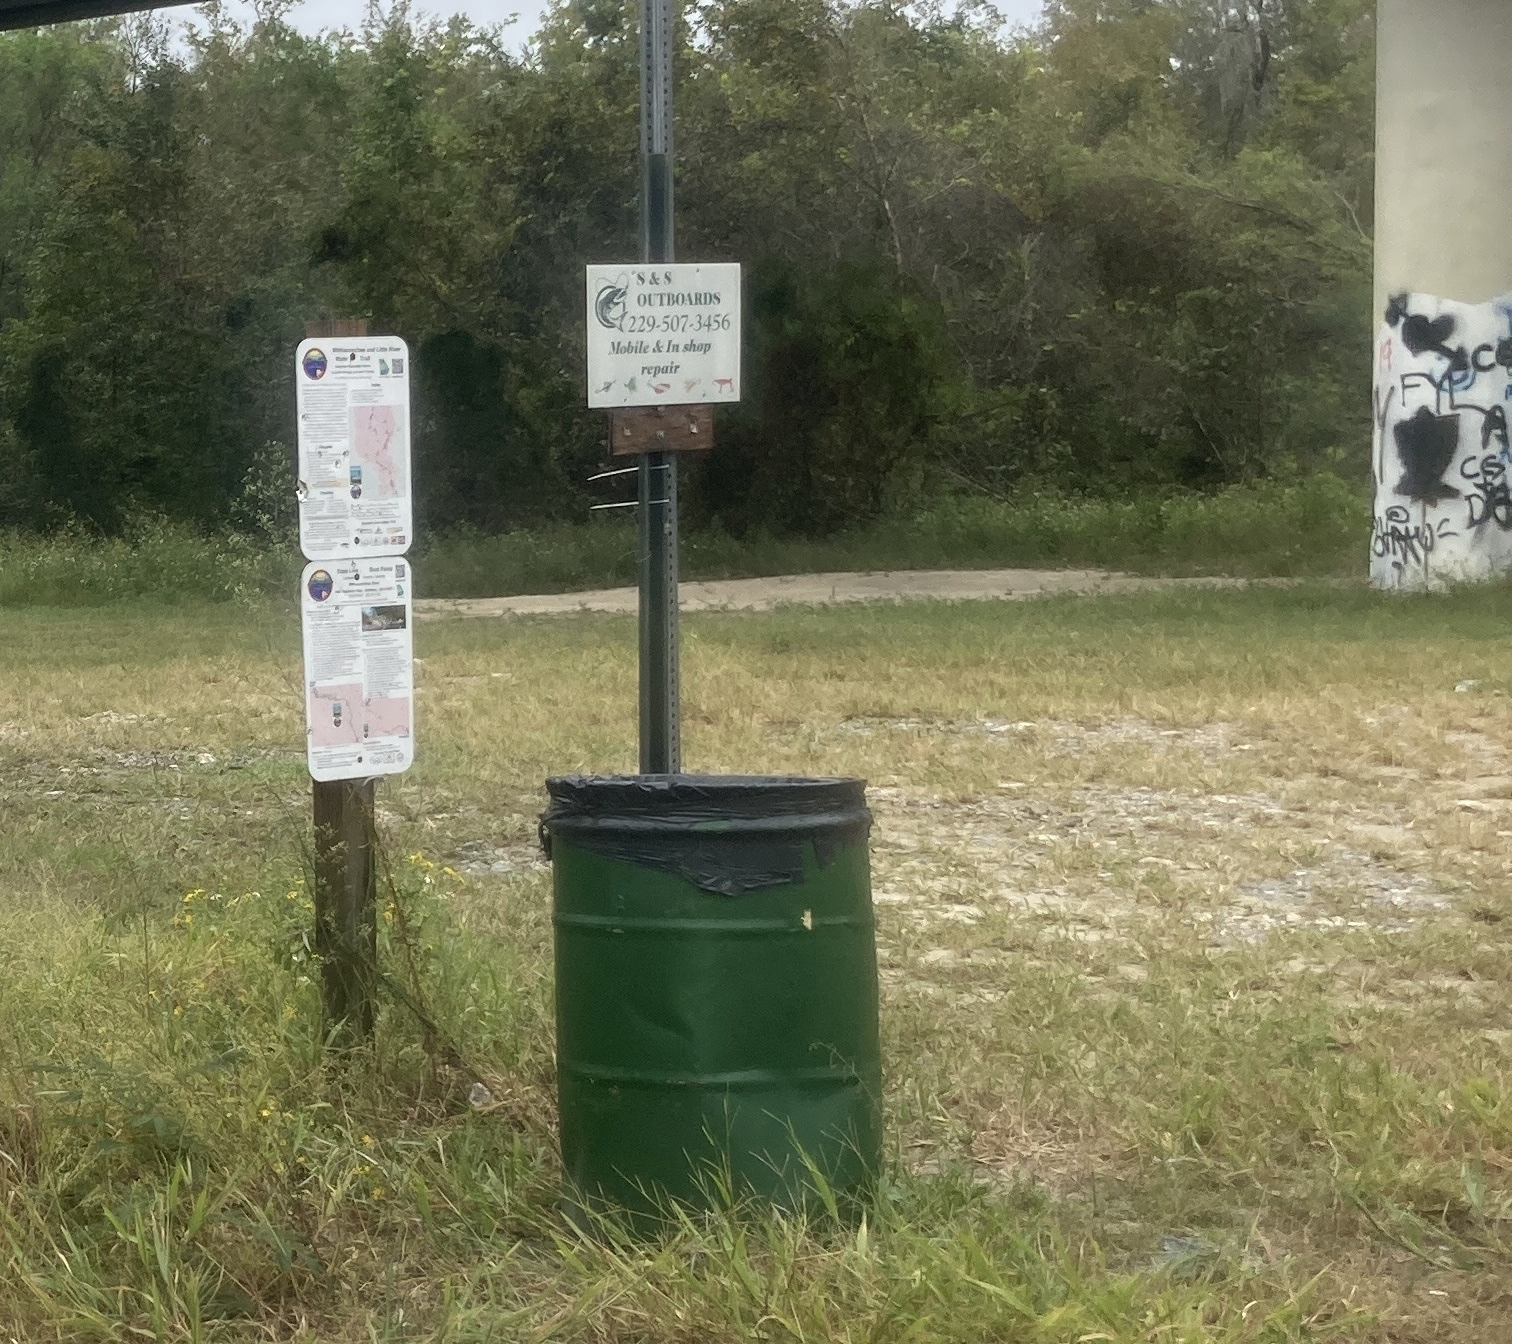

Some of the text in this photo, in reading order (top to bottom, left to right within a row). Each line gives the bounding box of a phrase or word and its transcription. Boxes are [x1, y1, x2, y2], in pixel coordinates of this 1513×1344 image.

[637, 270, 672, 285] S & S
[637, 292, 721, 307] OUTBOARDS
[627, 314, 731, 333] 229-507-3456
[608, 339, 712, 355] Mobile & In shop
[641, 361, 680, 377] repair
